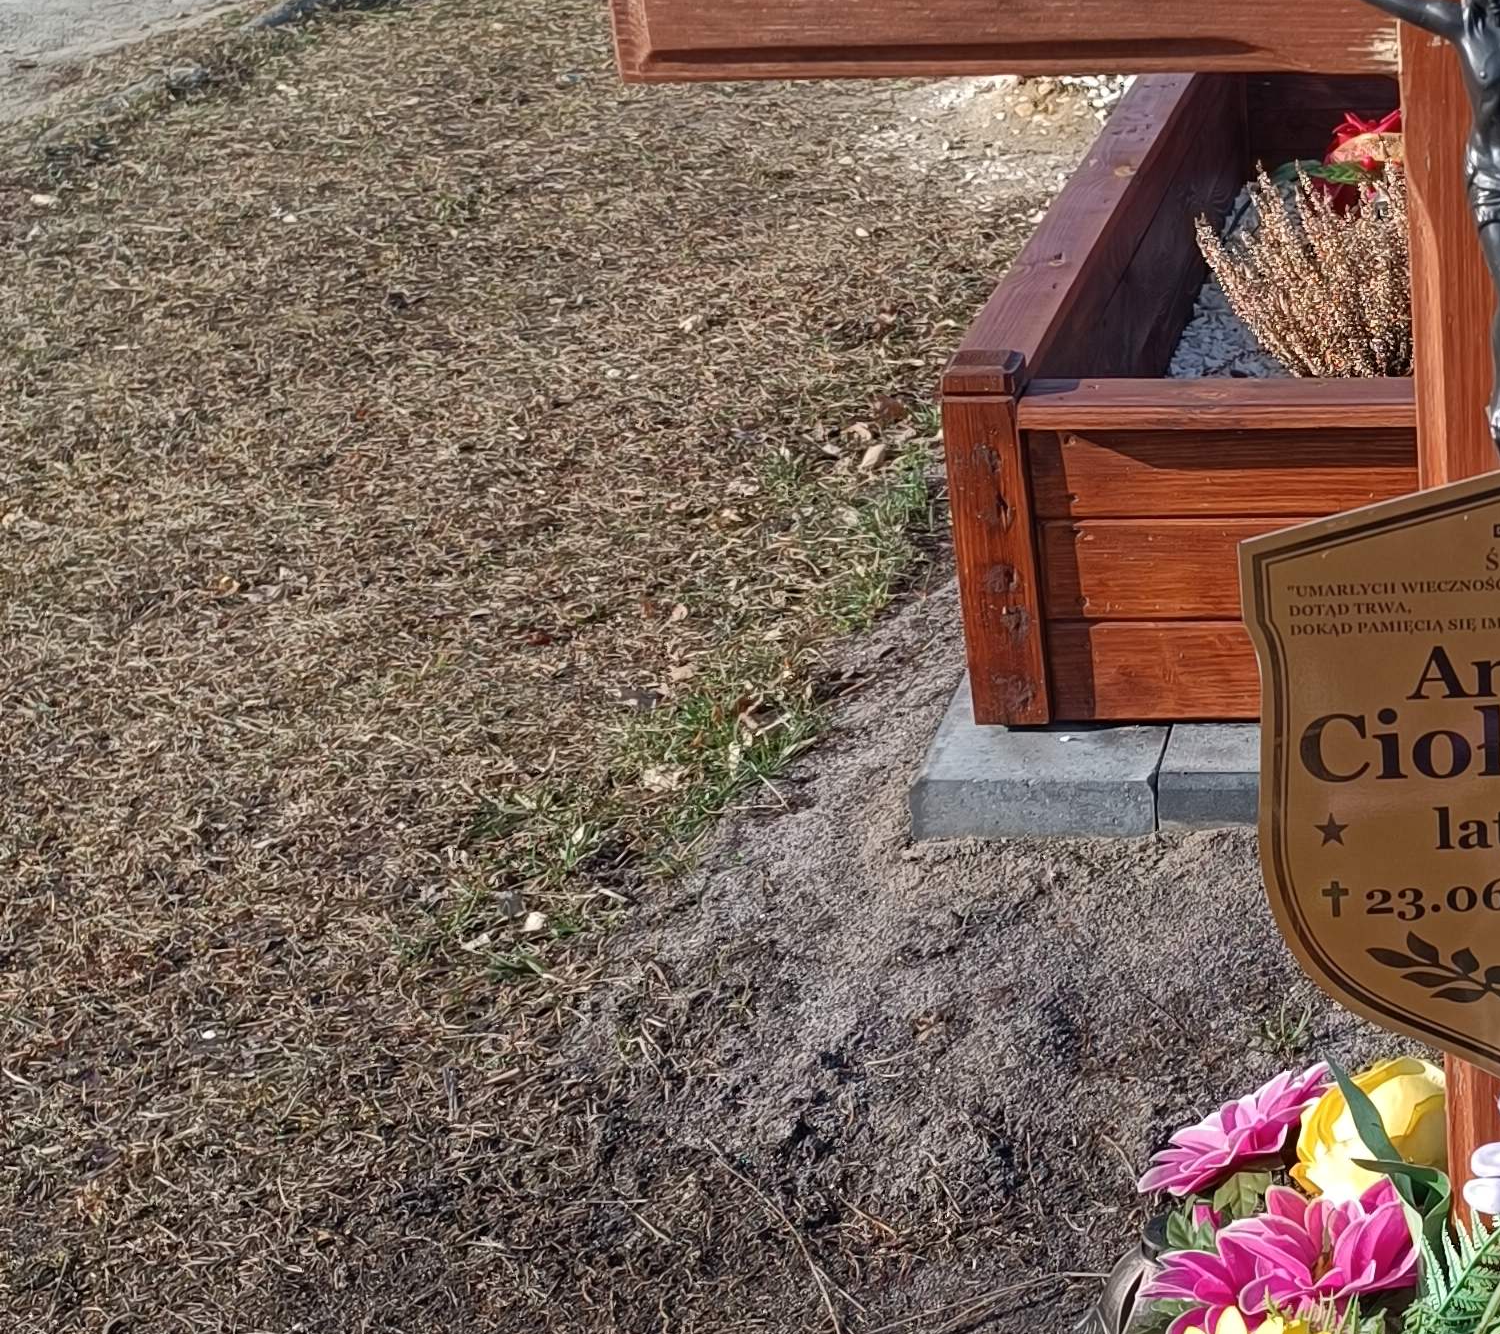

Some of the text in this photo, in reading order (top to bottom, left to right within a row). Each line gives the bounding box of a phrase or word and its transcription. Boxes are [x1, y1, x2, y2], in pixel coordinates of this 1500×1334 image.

[1485, 547, 1500, 572] Ś
[1289, 601, 1413, 618] DOTĄD TRWA,
[1290, 622, 1353, 637] DOKĄD
[1358, 619, 1444, 635] PAMIĘCIĄ
[1448, 617, 1477, 633] SIĘ
